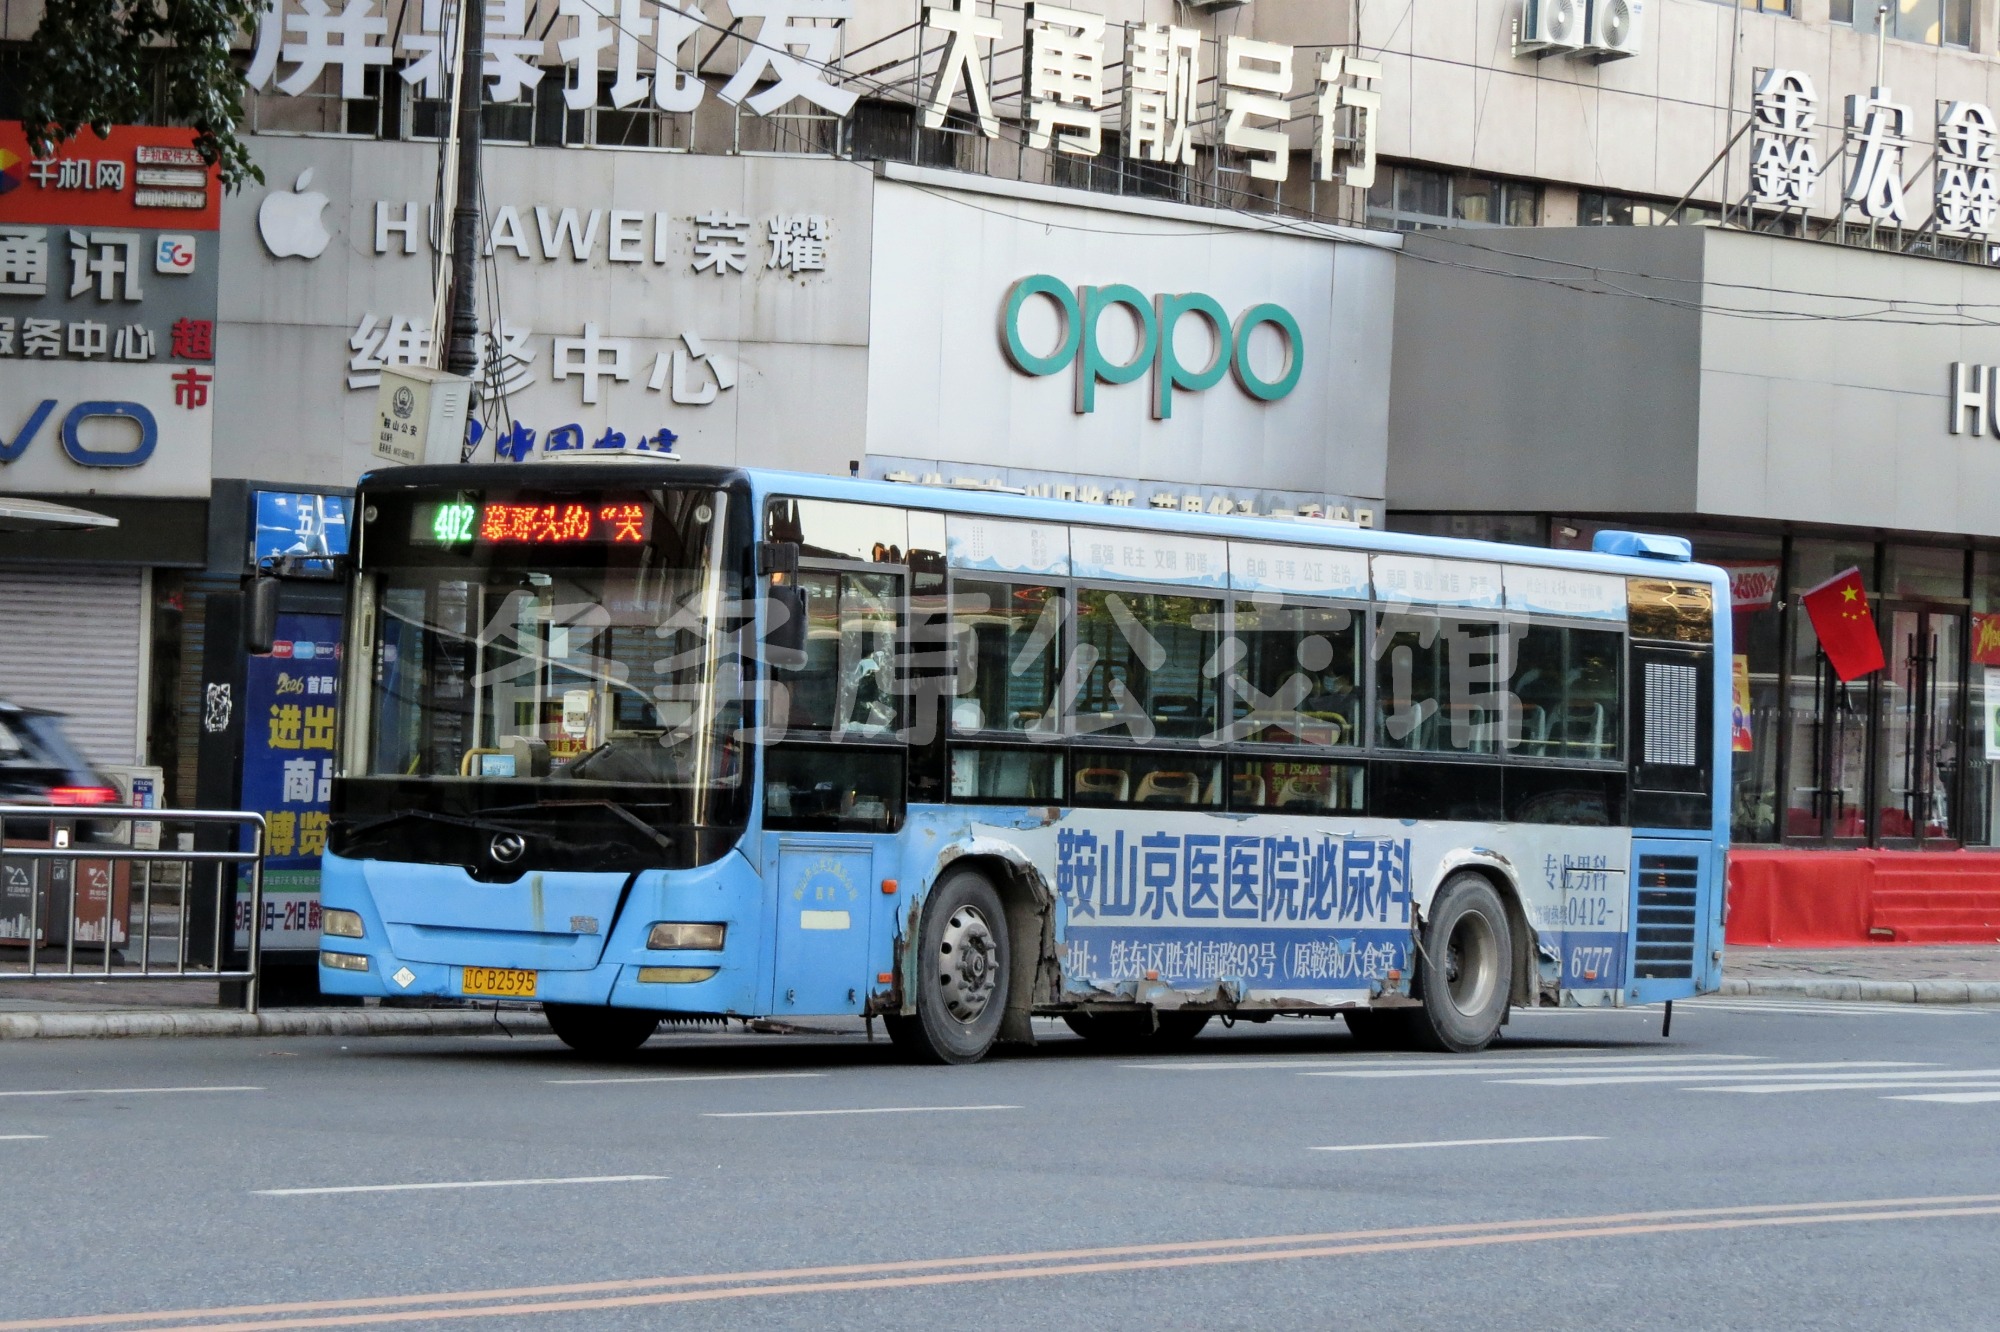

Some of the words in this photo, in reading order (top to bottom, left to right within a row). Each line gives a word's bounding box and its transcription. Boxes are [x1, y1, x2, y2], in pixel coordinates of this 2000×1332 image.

[159, 240, 192, 268] 5G
[692, 210, 827, 275] 荣耀
[171, 317, 213, 410] 超市
[347, 313, 735, 405] 维修中心
[434, 503, 475, 541] 402
[1056, 827, 1413, 924] 鞍山京医医院泌尿科
